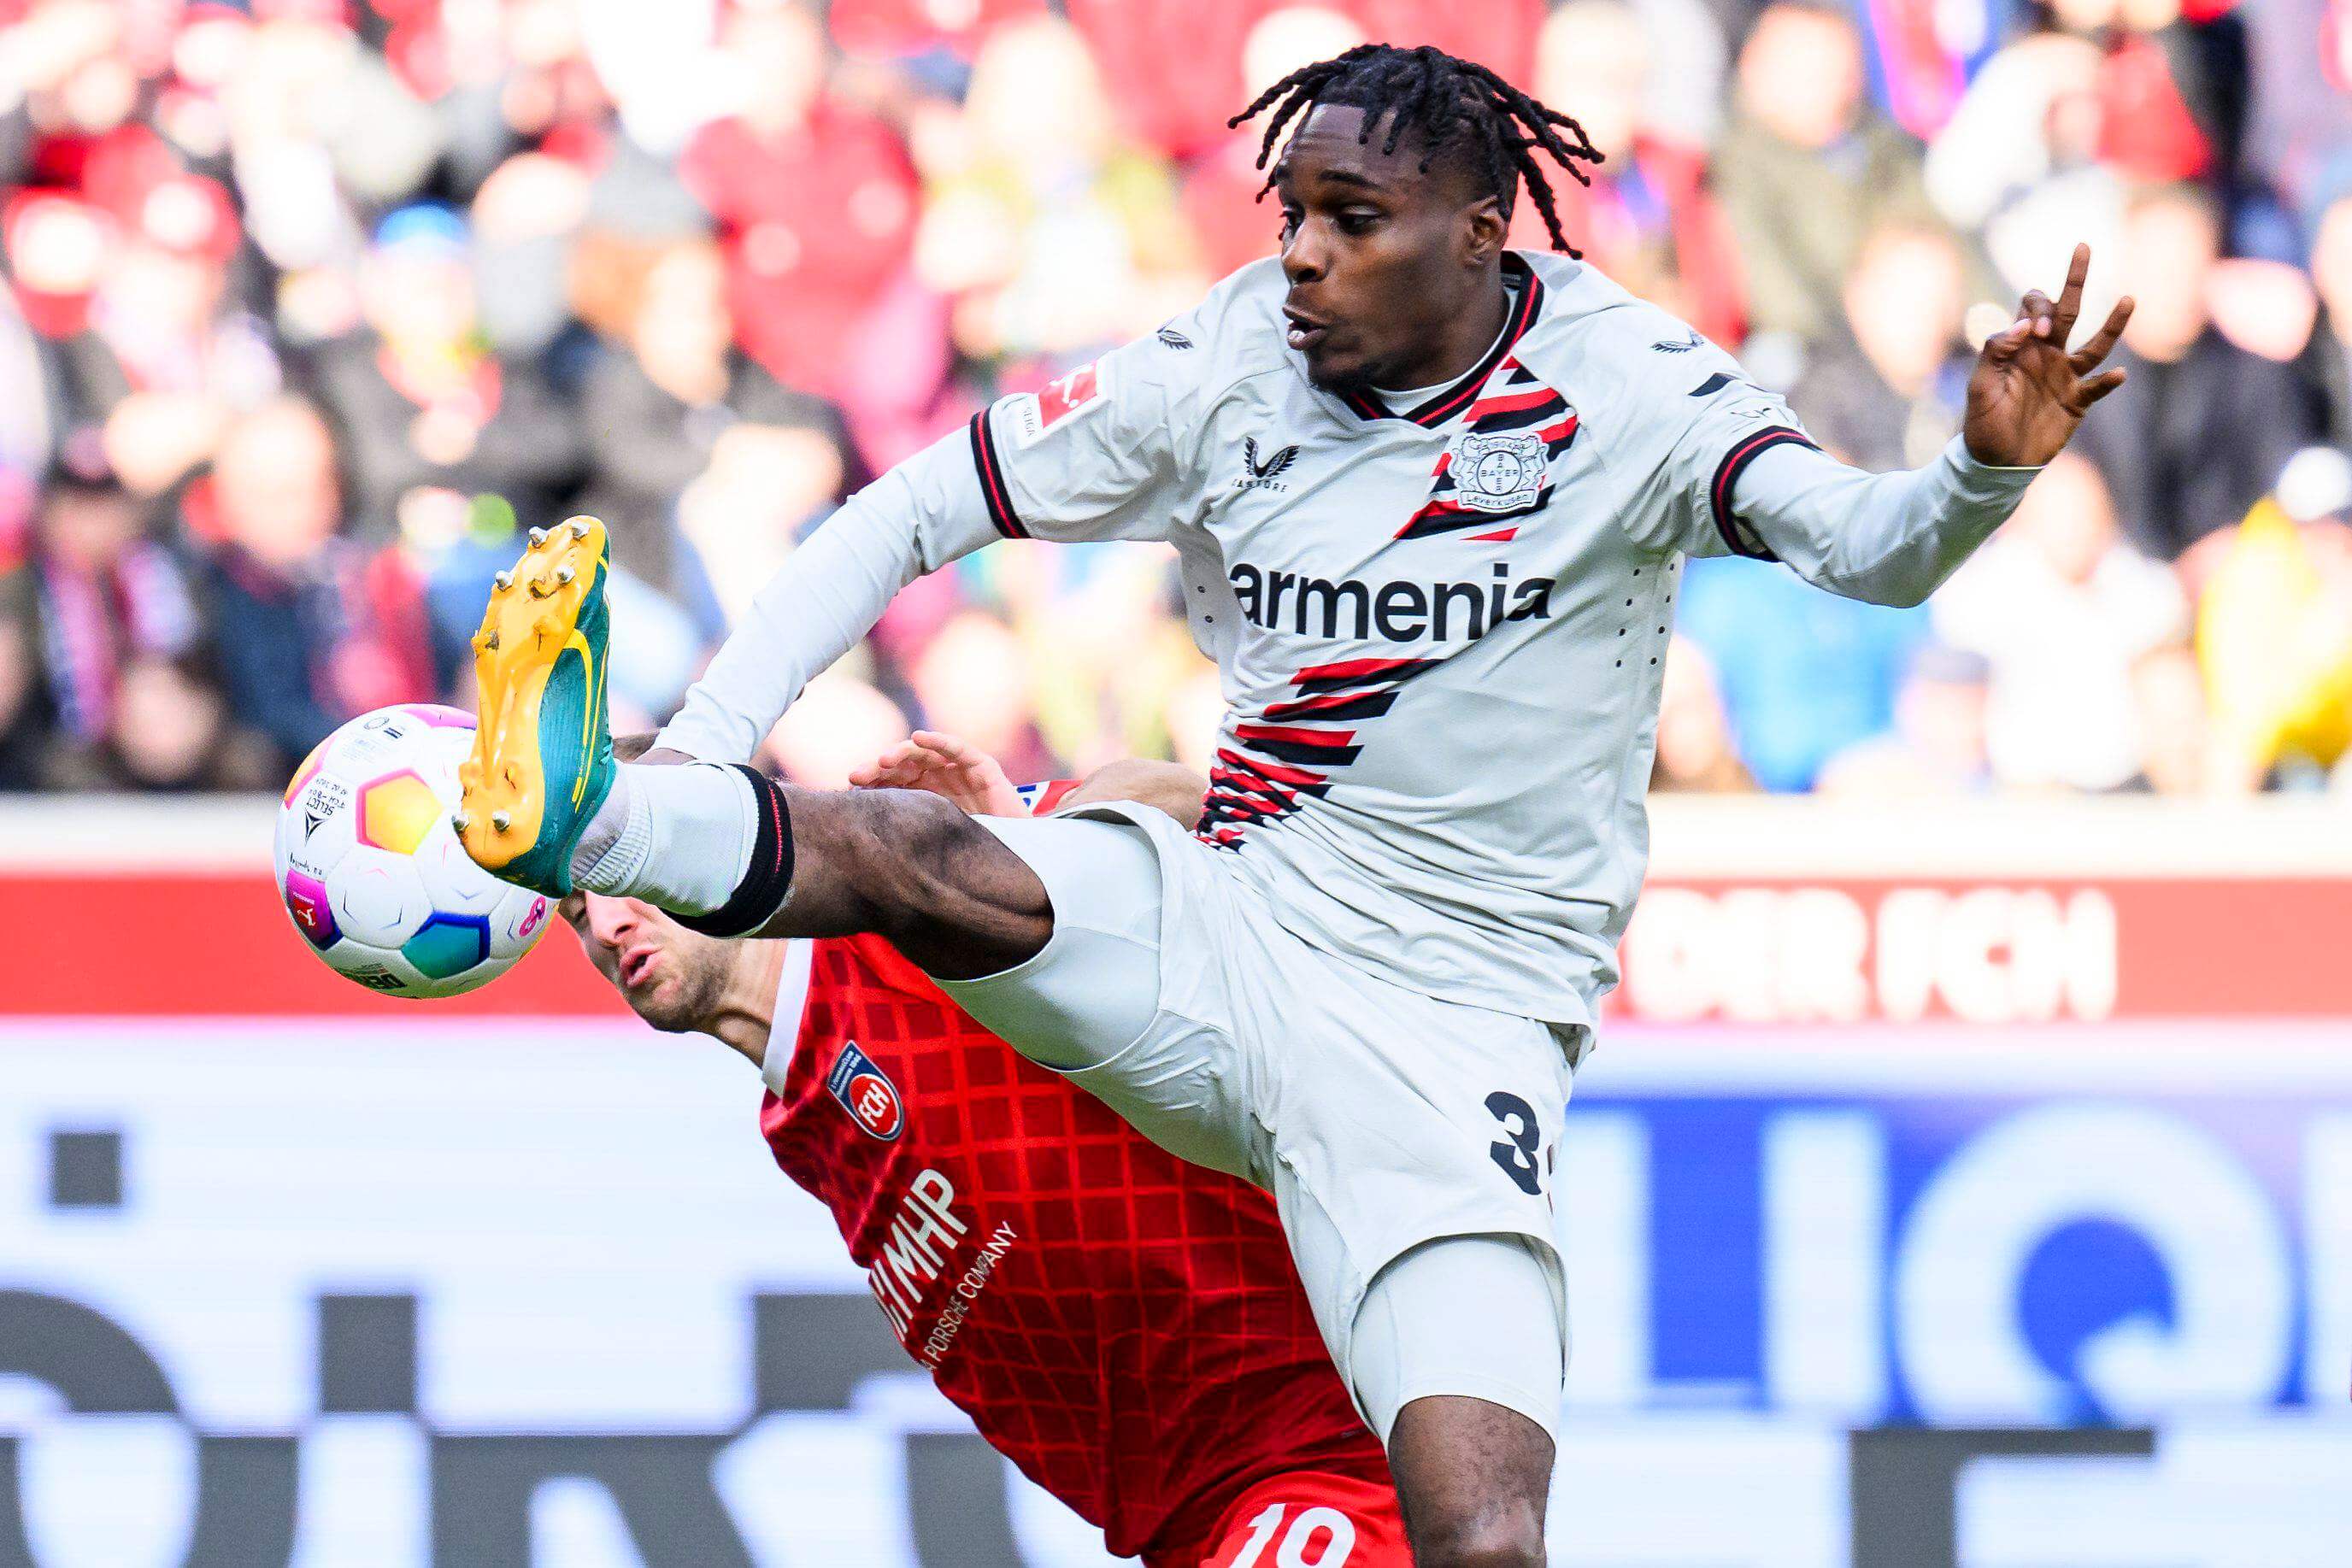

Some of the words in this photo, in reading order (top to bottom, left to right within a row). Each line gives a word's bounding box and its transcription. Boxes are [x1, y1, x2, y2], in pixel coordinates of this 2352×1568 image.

[306, 796, 335, 816] SELECT
[858, 1082, 890, 1128] FCH
[882, 1168, 969, 1304] MHP
[923, 1295, 970, 1362] PORSCHE
[956, 1219, 1018, 1300] COMPANY
